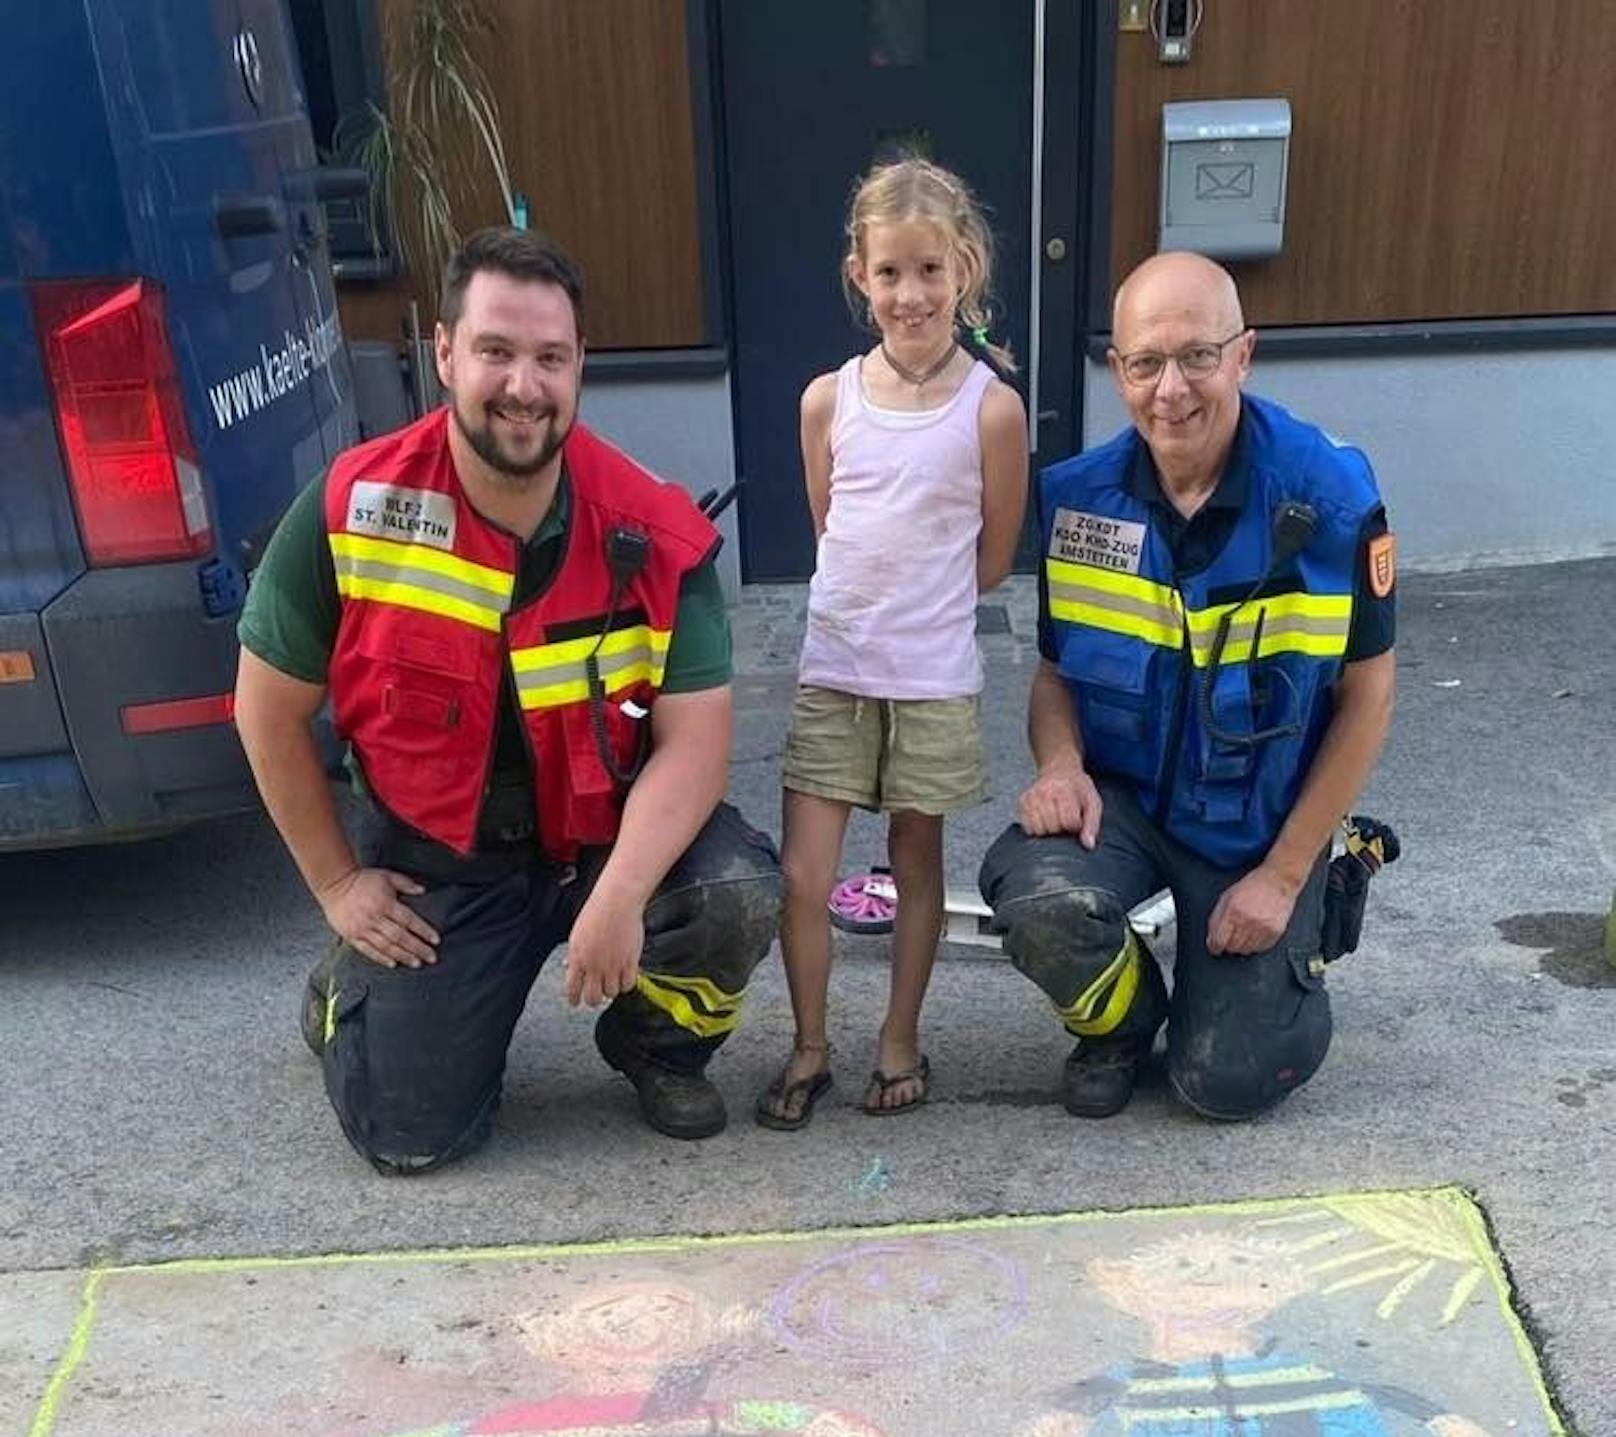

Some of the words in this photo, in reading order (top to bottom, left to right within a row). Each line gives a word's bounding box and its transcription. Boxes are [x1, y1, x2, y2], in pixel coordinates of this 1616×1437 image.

[355, 508, 376, 524] ST.
[381, 511, 448, 539] VALENTIN
[1060, 543, 1128, 568] AMSTETTEN
